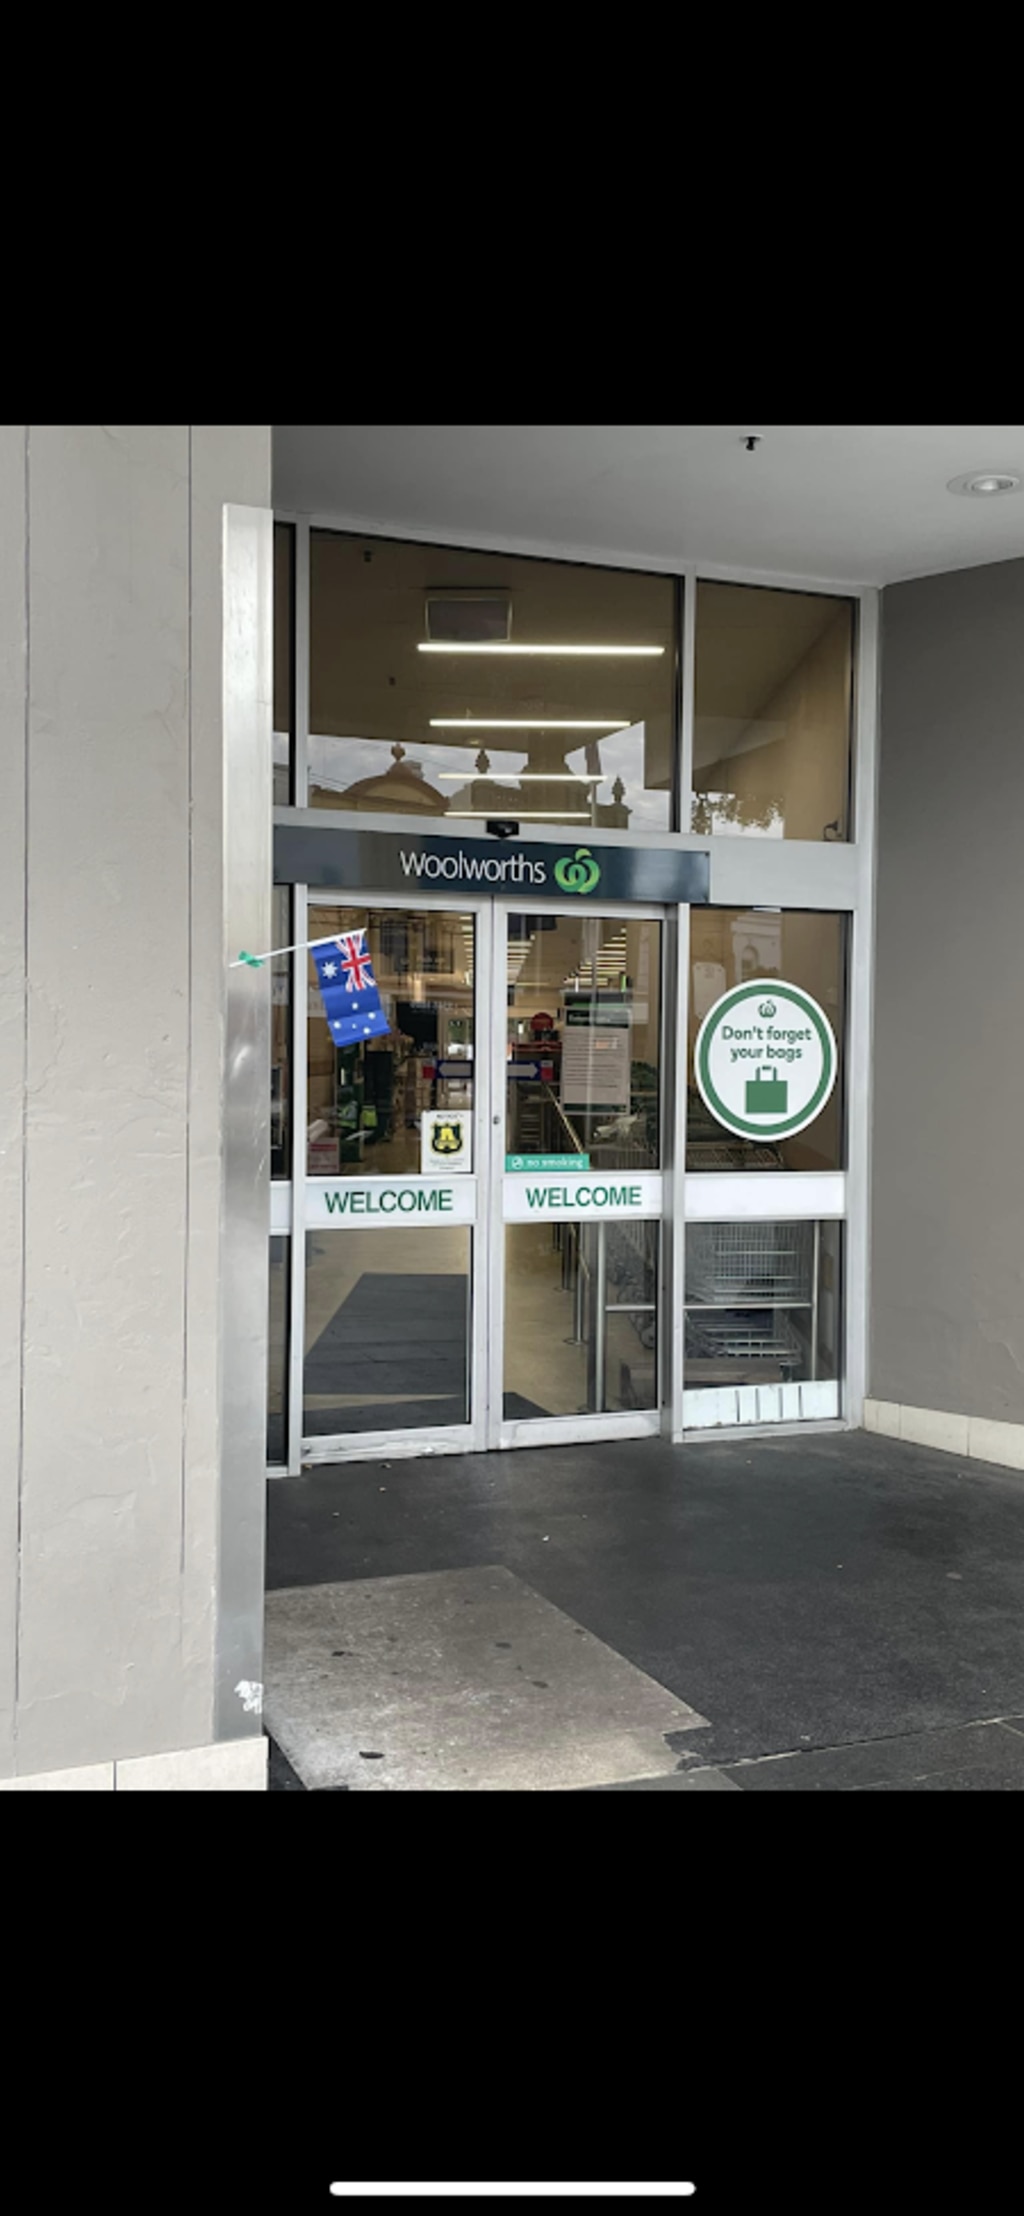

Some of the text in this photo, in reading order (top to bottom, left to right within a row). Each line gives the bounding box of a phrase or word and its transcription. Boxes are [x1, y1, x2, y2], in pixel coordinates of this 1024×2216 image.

[400, 850, 546, 884] Woolworths
[722, 1025, 811, 1044] Don't forget
[730, 1045, 802, 1062] your bags
[527, 1157, 584, 1169] no smoking
[325, 1189, 453, 1213] WELCOME
[526, 1186, 643, 1208] WELCOME
